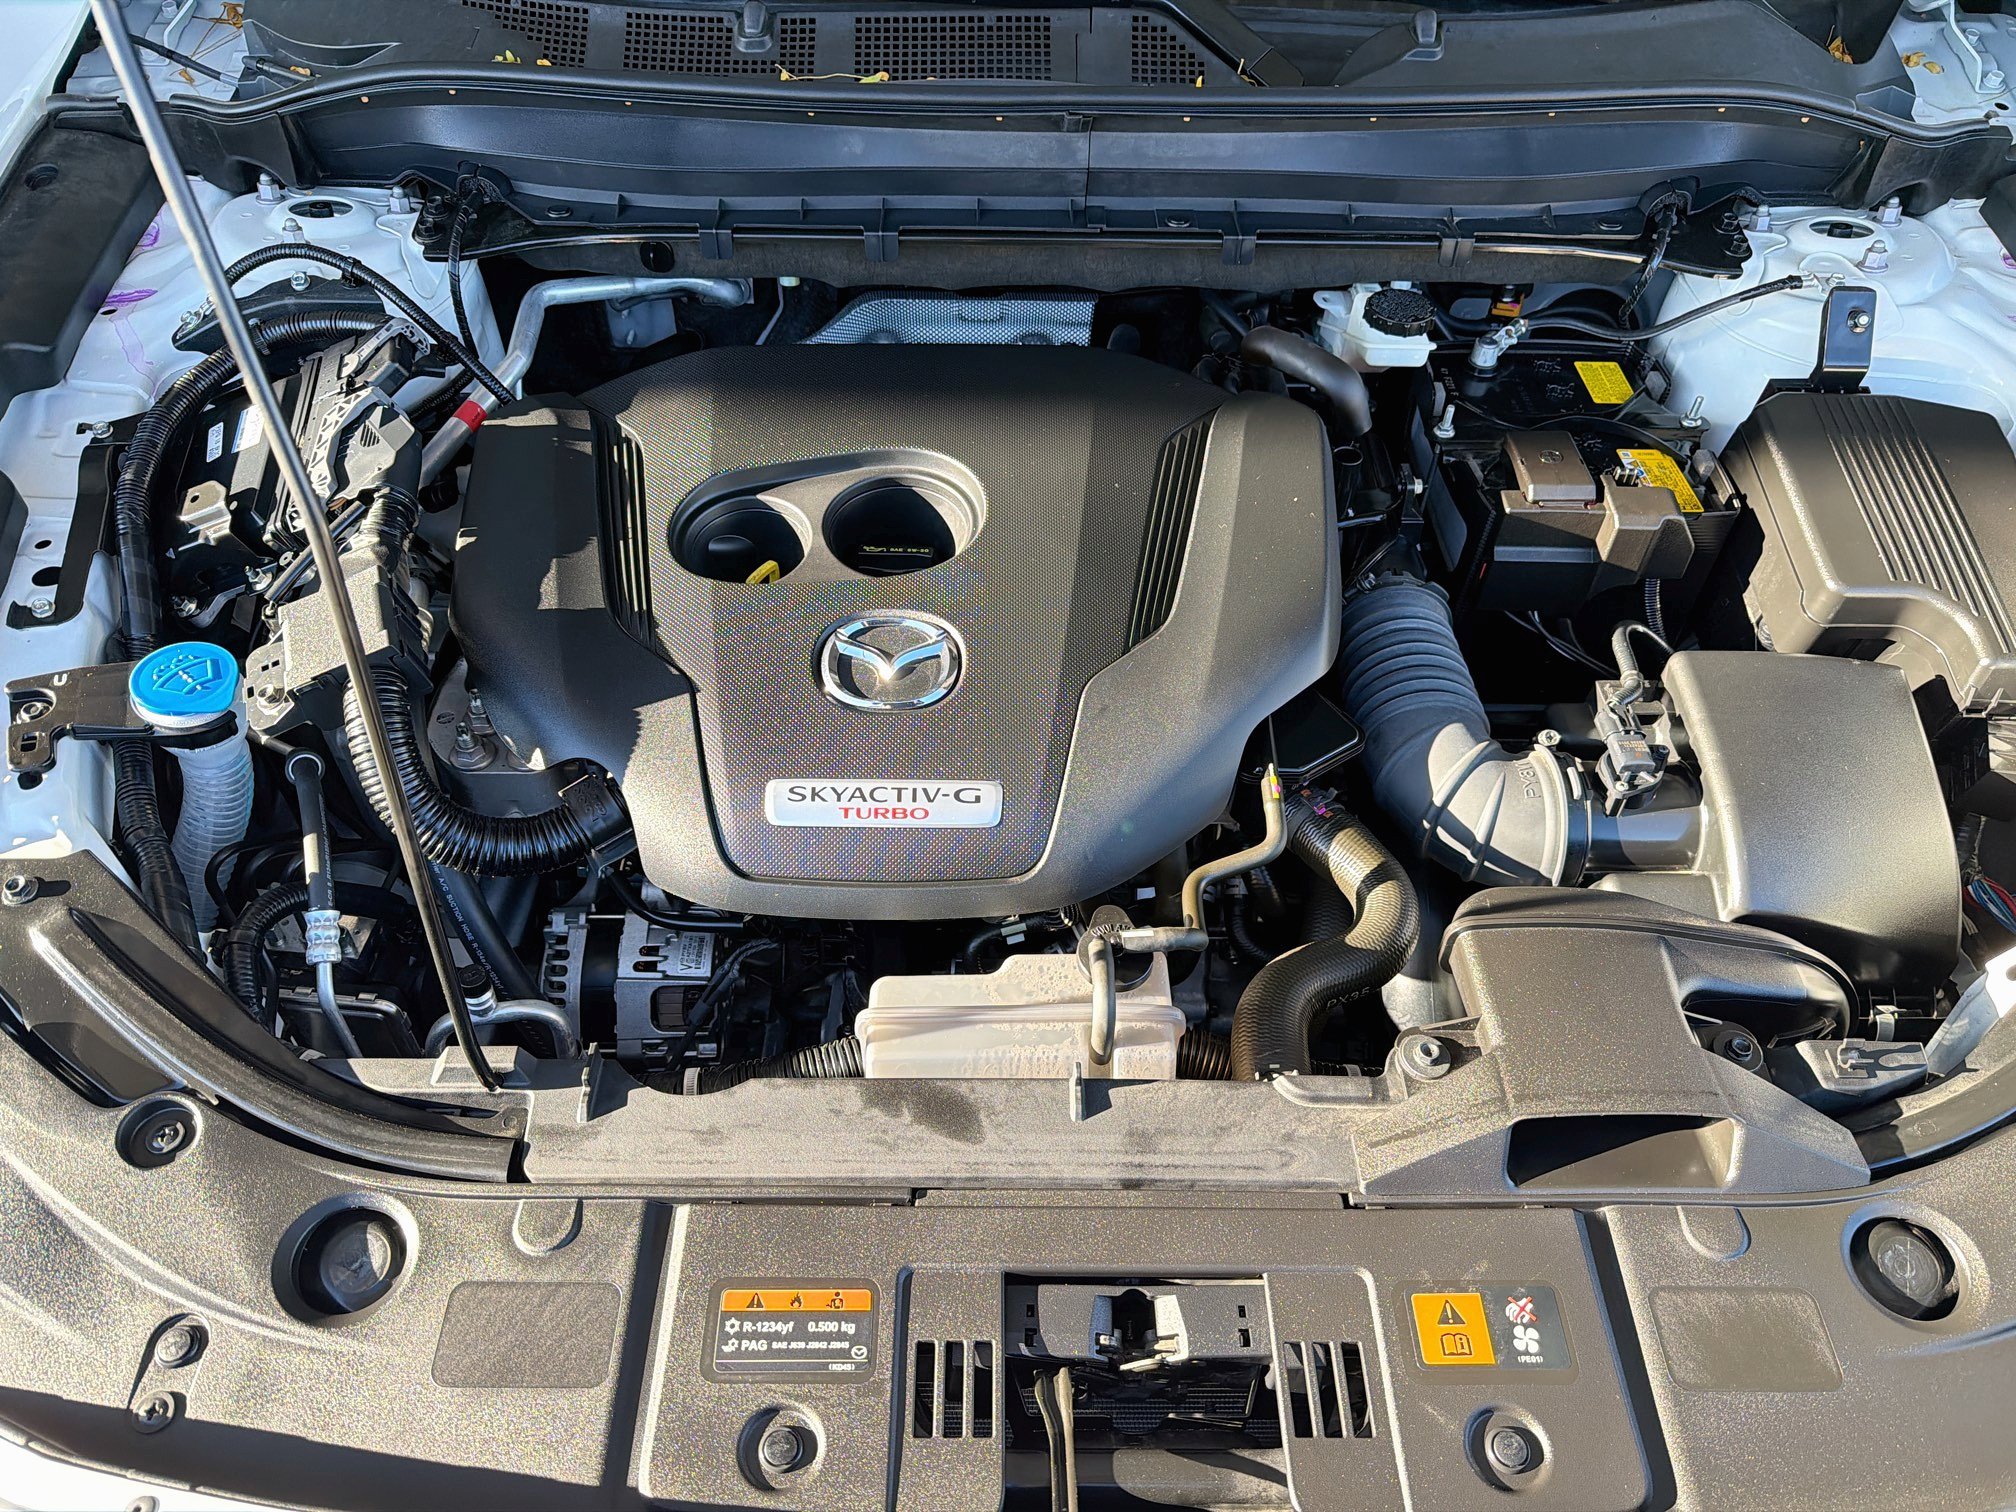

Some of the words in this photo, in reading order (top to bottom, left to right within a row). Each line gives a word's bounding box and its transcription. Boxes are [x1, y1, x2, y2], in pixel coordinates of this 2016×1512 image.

[787, 785, 982, 804] SKYACTIV-G
[838, 807, 930, 820] TURBO
[438, 877, 450, 892] A/C
[446, 894, 465, 922] SUCTION
[461, 923, 475, 941] HOSE
[742, 1321, 795, 1334] R-1234yf
[807, 1321, 839, 1332] 0.500
[841, 1321, 856, 1335] kg
[741, 1340, 768, 1351] PAG
[771, 1341, 788, 1349] SAE
[1517, 1355, 1544, 1363] (PE01)
